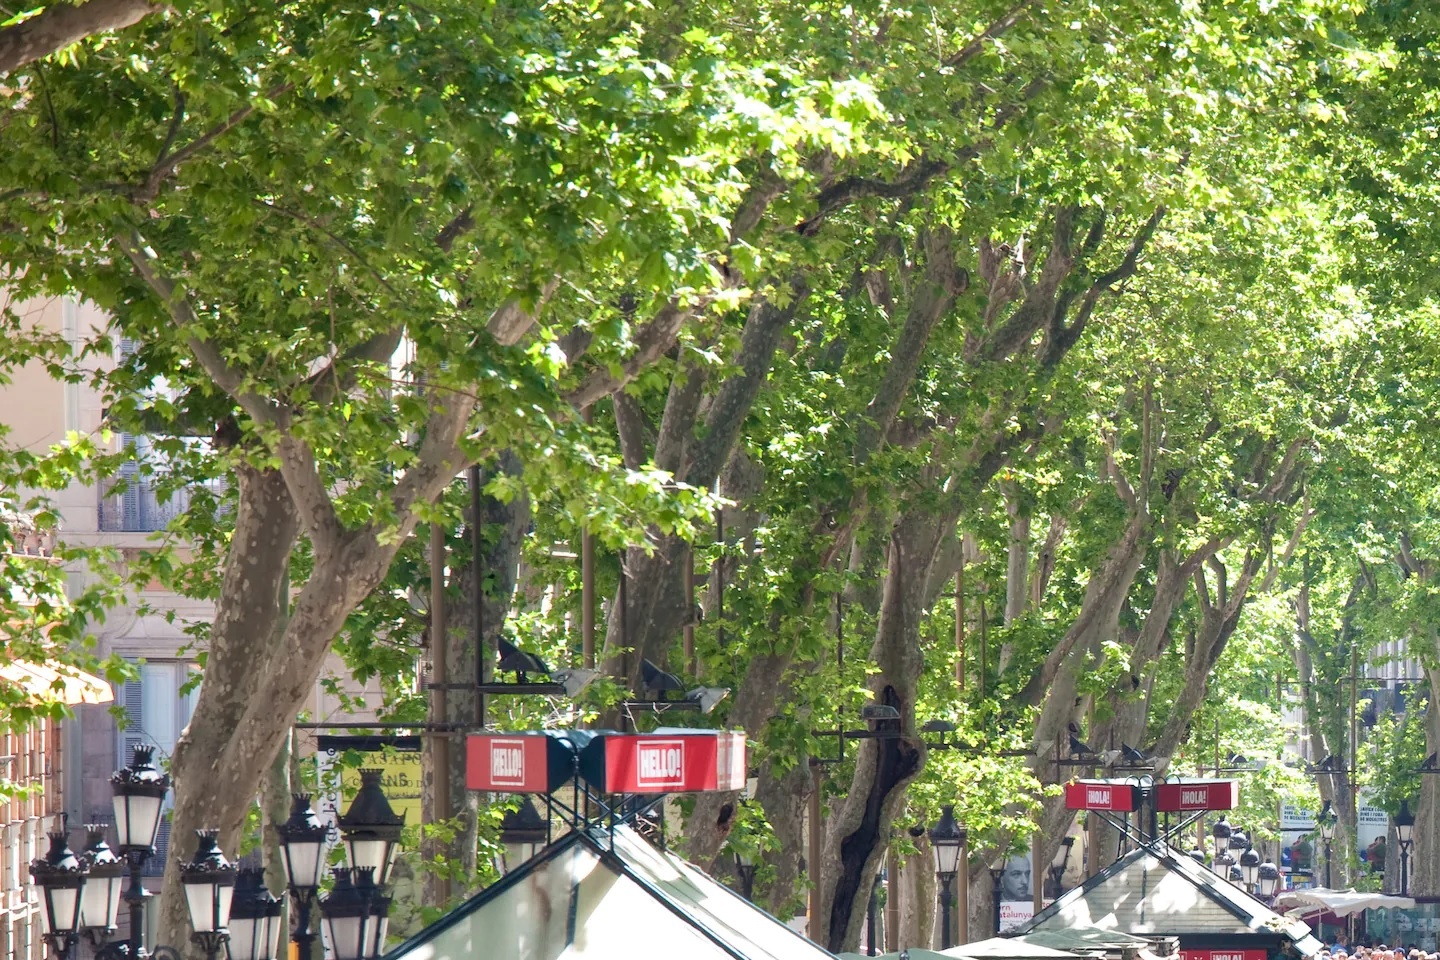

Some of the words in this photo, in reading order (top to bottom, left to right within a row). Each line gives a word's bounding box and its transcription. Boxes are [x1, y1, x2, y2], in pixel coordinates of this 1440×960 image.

[493, 748, 522, 777] HELLO!
[640, 748, 682, 778] HELLO!
[1088, 790, 1110, 804] ¡HOLA!
[1182, 790, 1206, 804] ¡HOLA!
